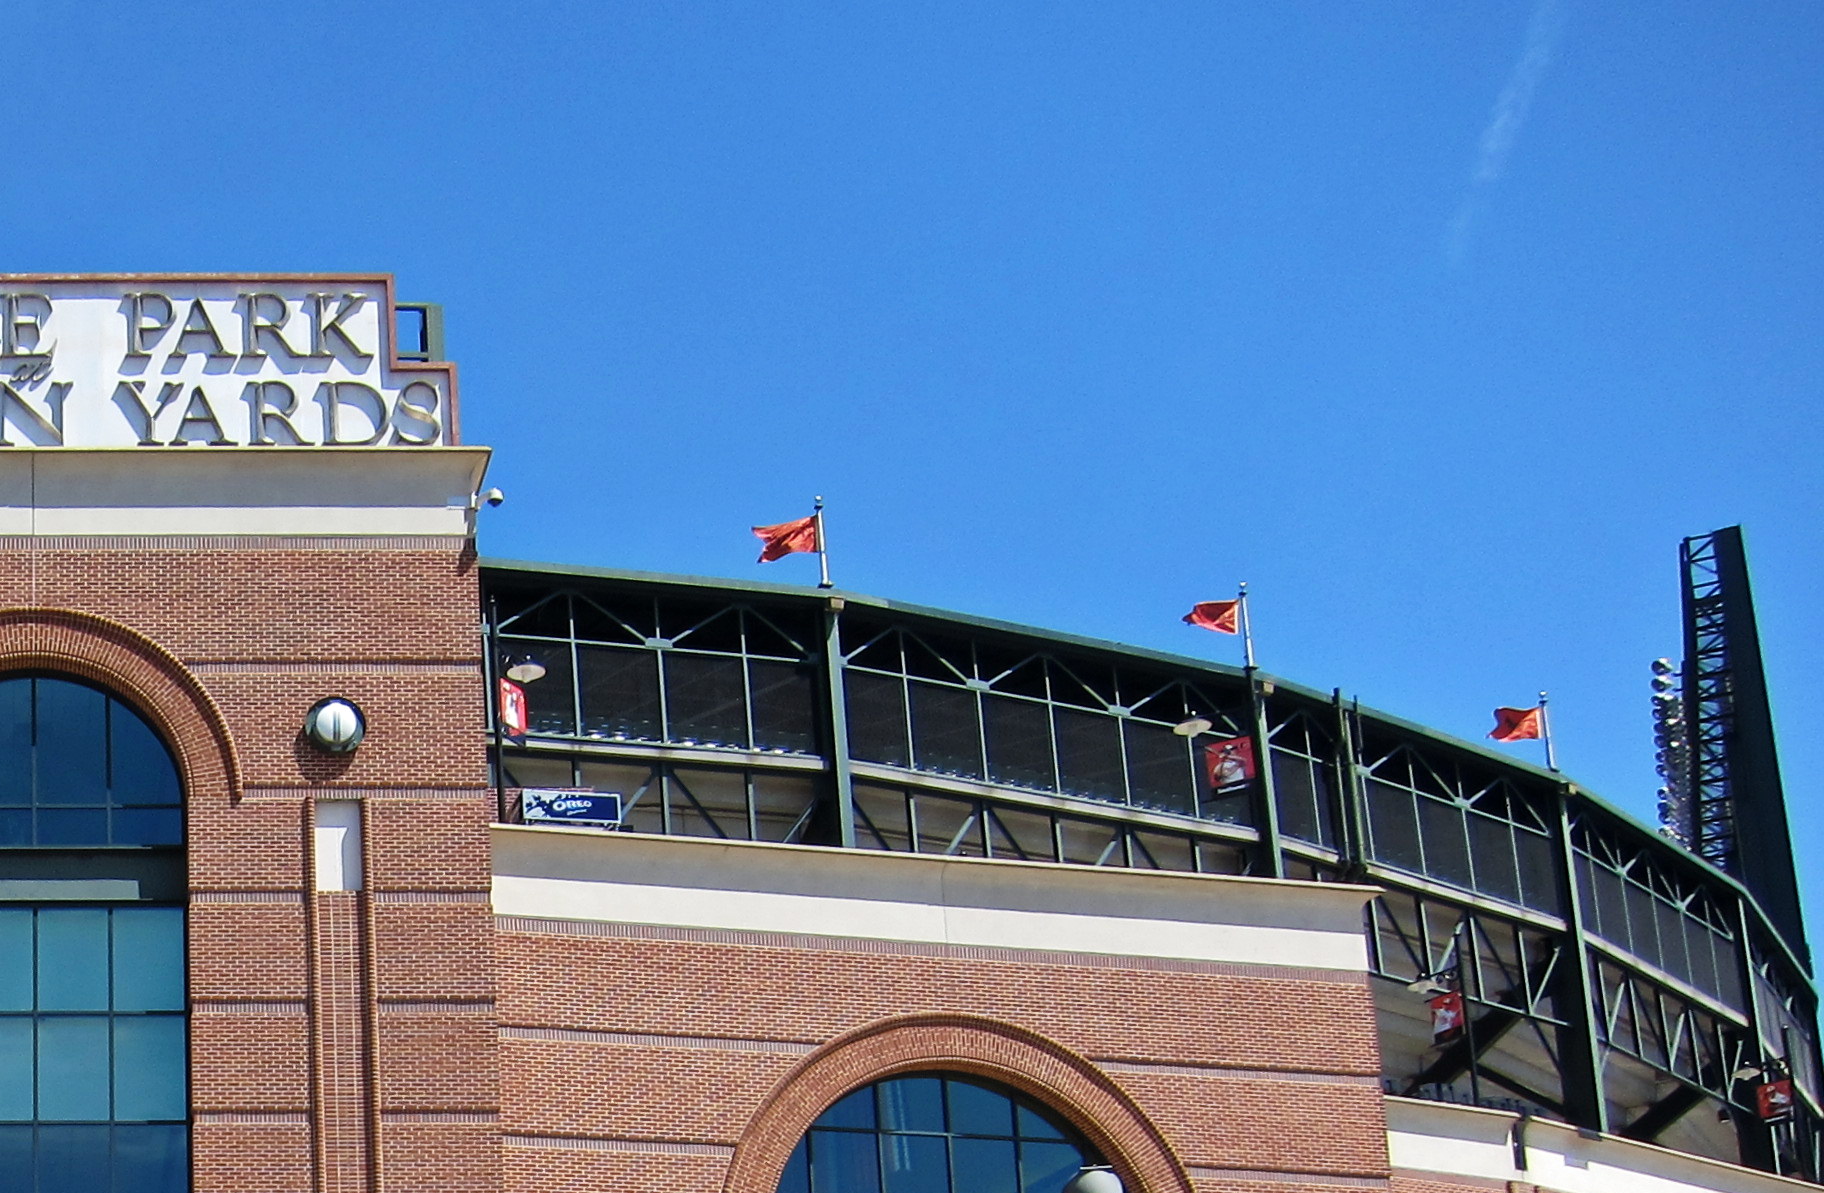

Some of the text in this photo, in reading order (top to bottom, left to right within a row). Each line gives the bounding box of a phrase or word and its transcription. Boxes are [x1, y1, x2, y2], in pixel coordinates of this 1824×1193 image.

[124, 291, 375, 360] PARK
[117, 380, 441, 447] YARDS
[552, 799, 593, 812] OREO
